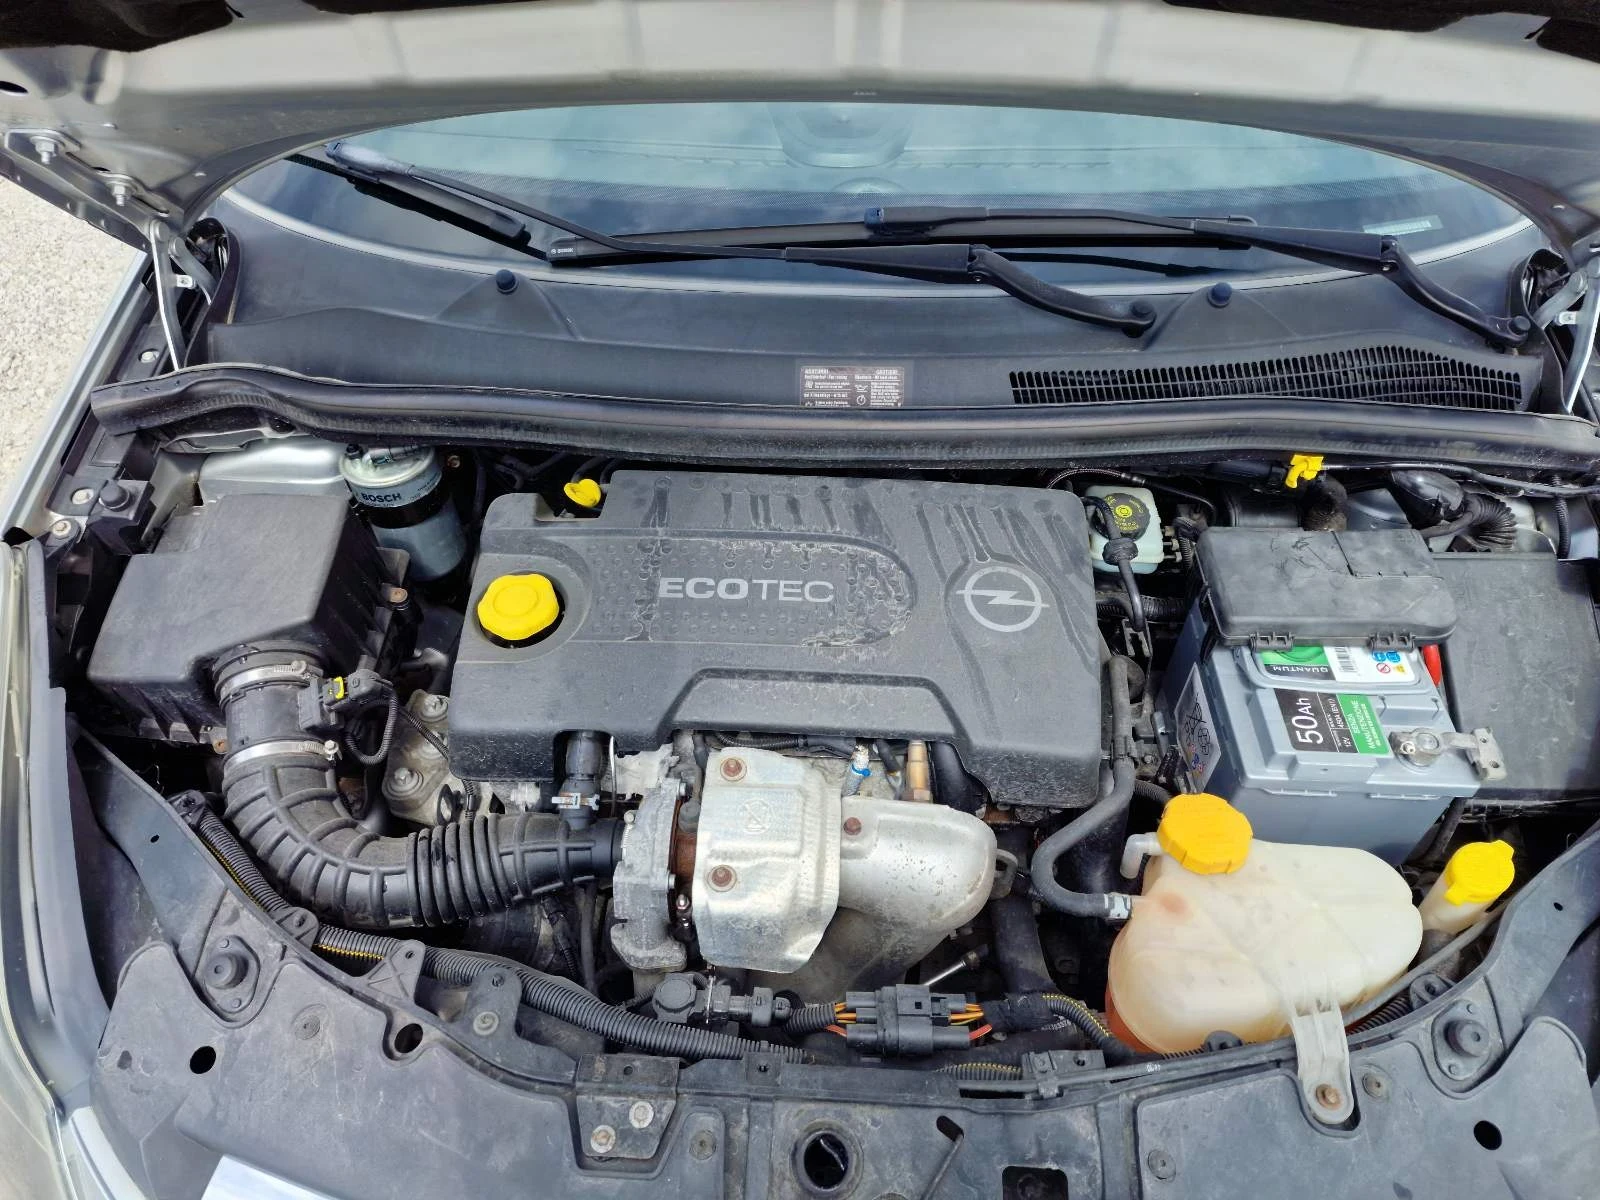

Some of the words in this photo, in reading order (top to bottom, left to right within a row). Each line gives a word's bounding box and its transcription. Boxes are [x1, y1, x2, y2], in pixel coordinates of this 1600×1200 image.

[361, 492, 402, 503] BOSCH
[658, 577, 835, 602] ECOTEC
[1273, 665, 1329, 673] QUANTUM
[1291, 697, 1324, 745] 50Ah
[1346, 713, 1361, 734] SENZA
[1351, 699, 1376, 749] MANUTENZIONE
